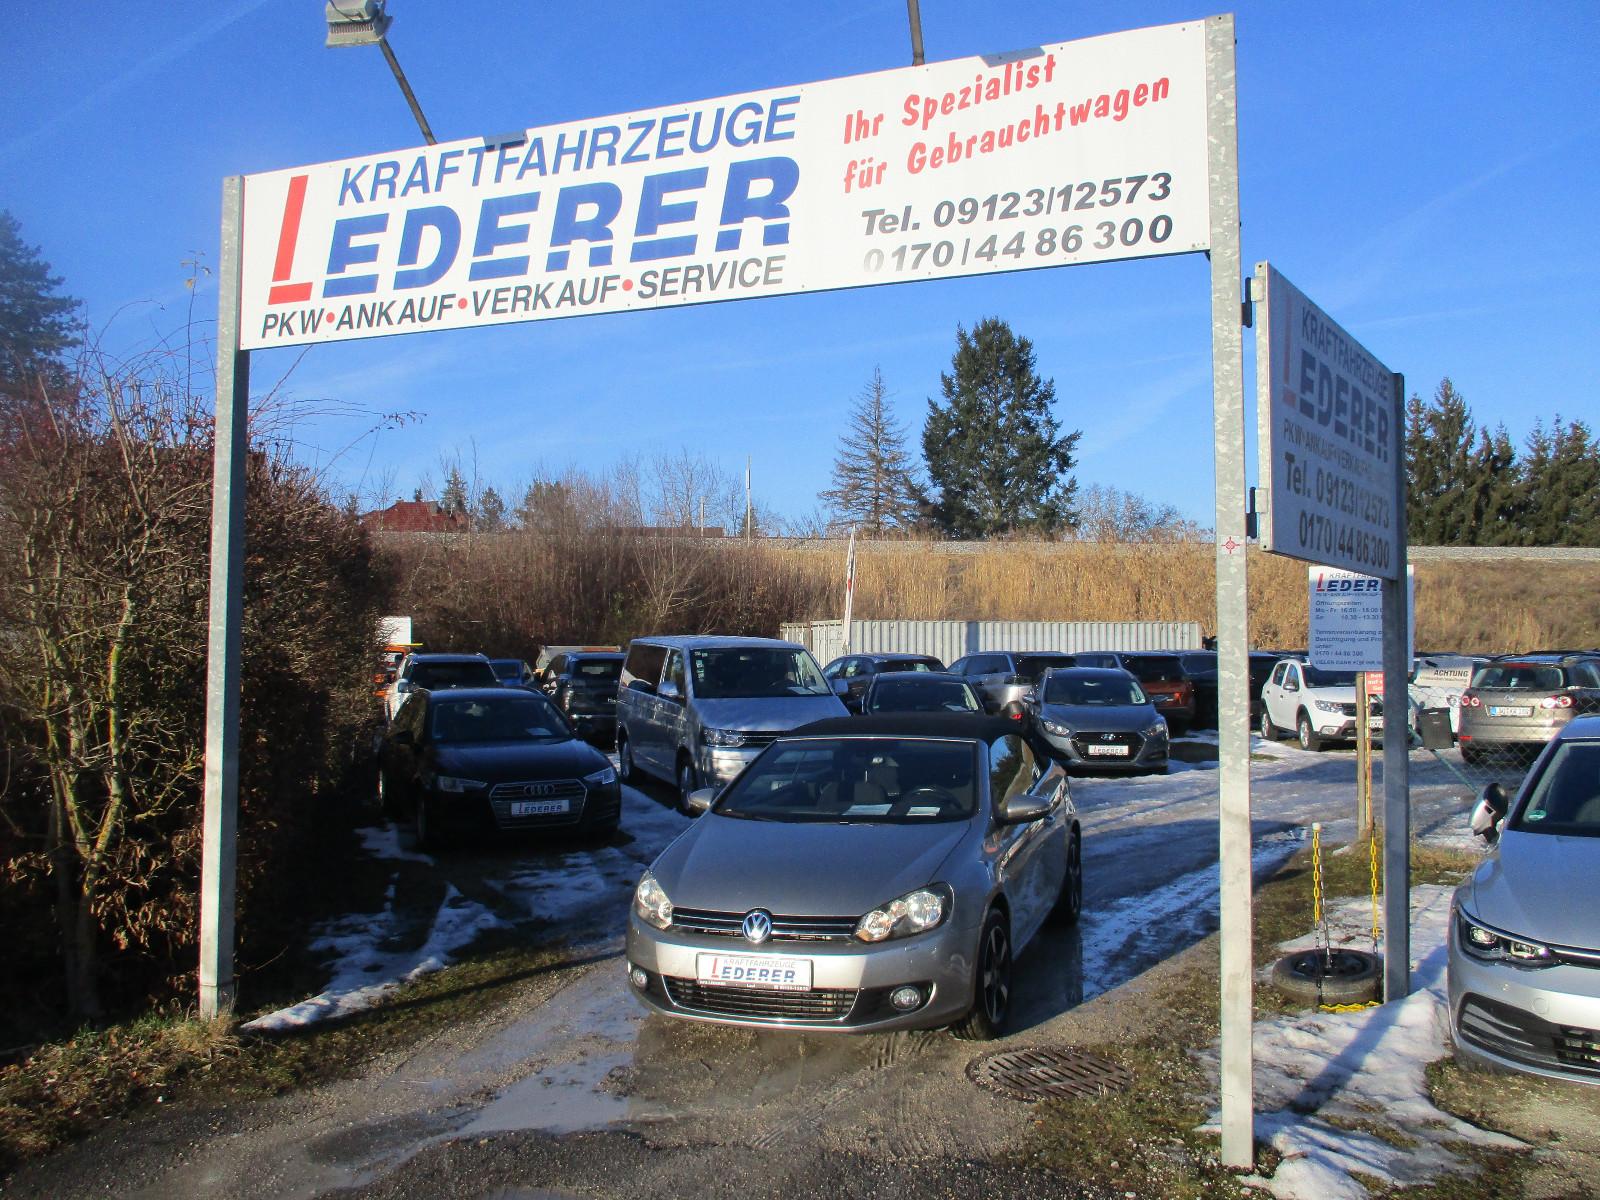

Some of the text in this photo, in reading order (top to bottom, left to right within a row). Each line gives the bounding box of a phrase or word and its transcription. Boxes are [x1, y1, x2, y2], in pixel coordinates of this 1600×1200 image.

[843, 54, 1057, 145] Ihr Spezialist
[338, 95, 801, 206] KRAFTFAHRZEUGE
[843, 77, 1170, 193] für Gebrauchtwagen
[267, 155, 801, 306] LEDERER
[861, 204, 921, 236] Tel.
[1282, 292, 1390, 463] LEDERER
[1302, 305, 1389, 402] KRAFTFAHRZEUGE
[1284, 451, 1311, 498] Tel.
[1316, 572, 1383, 592] LEDER
[1434, 670, 1469, 678] ACHTUNG
[711, 957, 796, 983] LEDERER
[723, 958, 797, 968] KRAFTFAHRZEUGE
